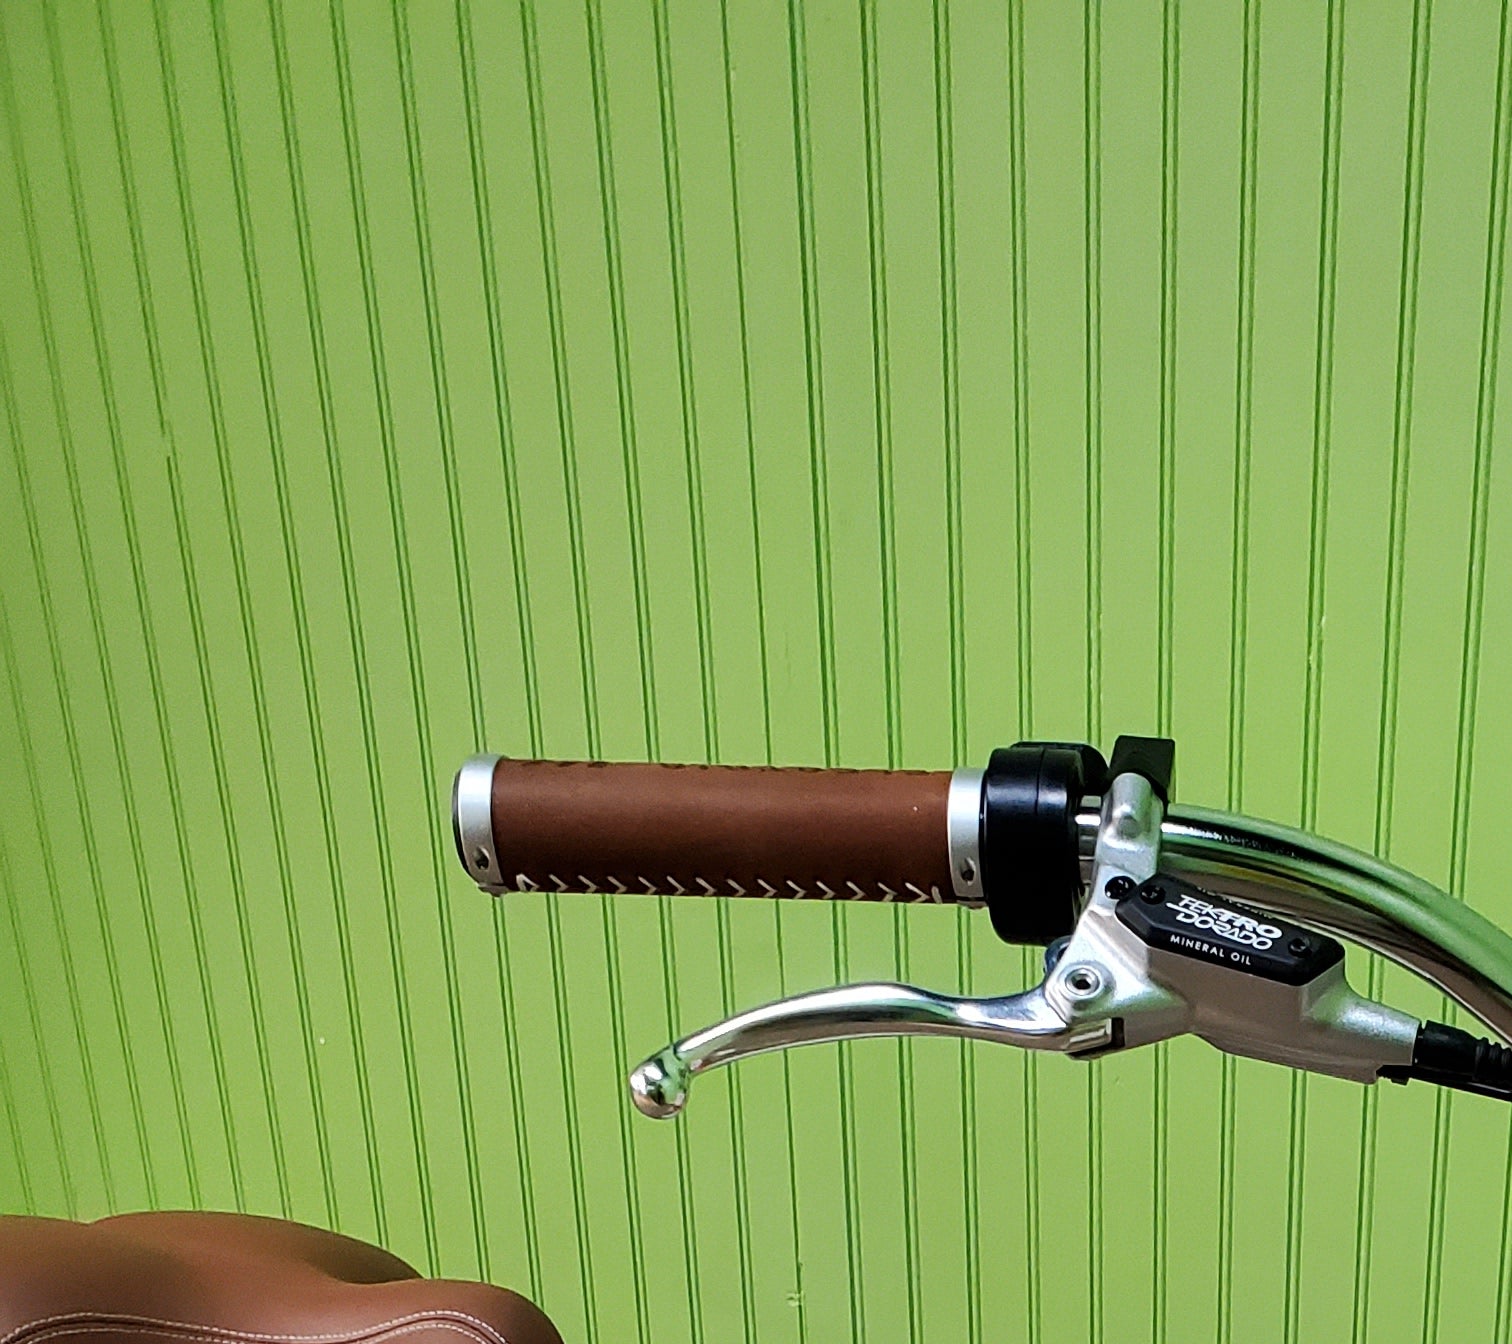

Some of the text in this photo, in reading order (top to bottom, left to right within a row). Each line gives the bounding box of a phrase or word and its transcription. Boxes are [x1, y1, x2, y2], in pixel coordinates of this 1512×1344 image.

[1179, 894, 1283, 939] TEKTRO
[1170, 934, 1252, 966] MINERAL OIL
